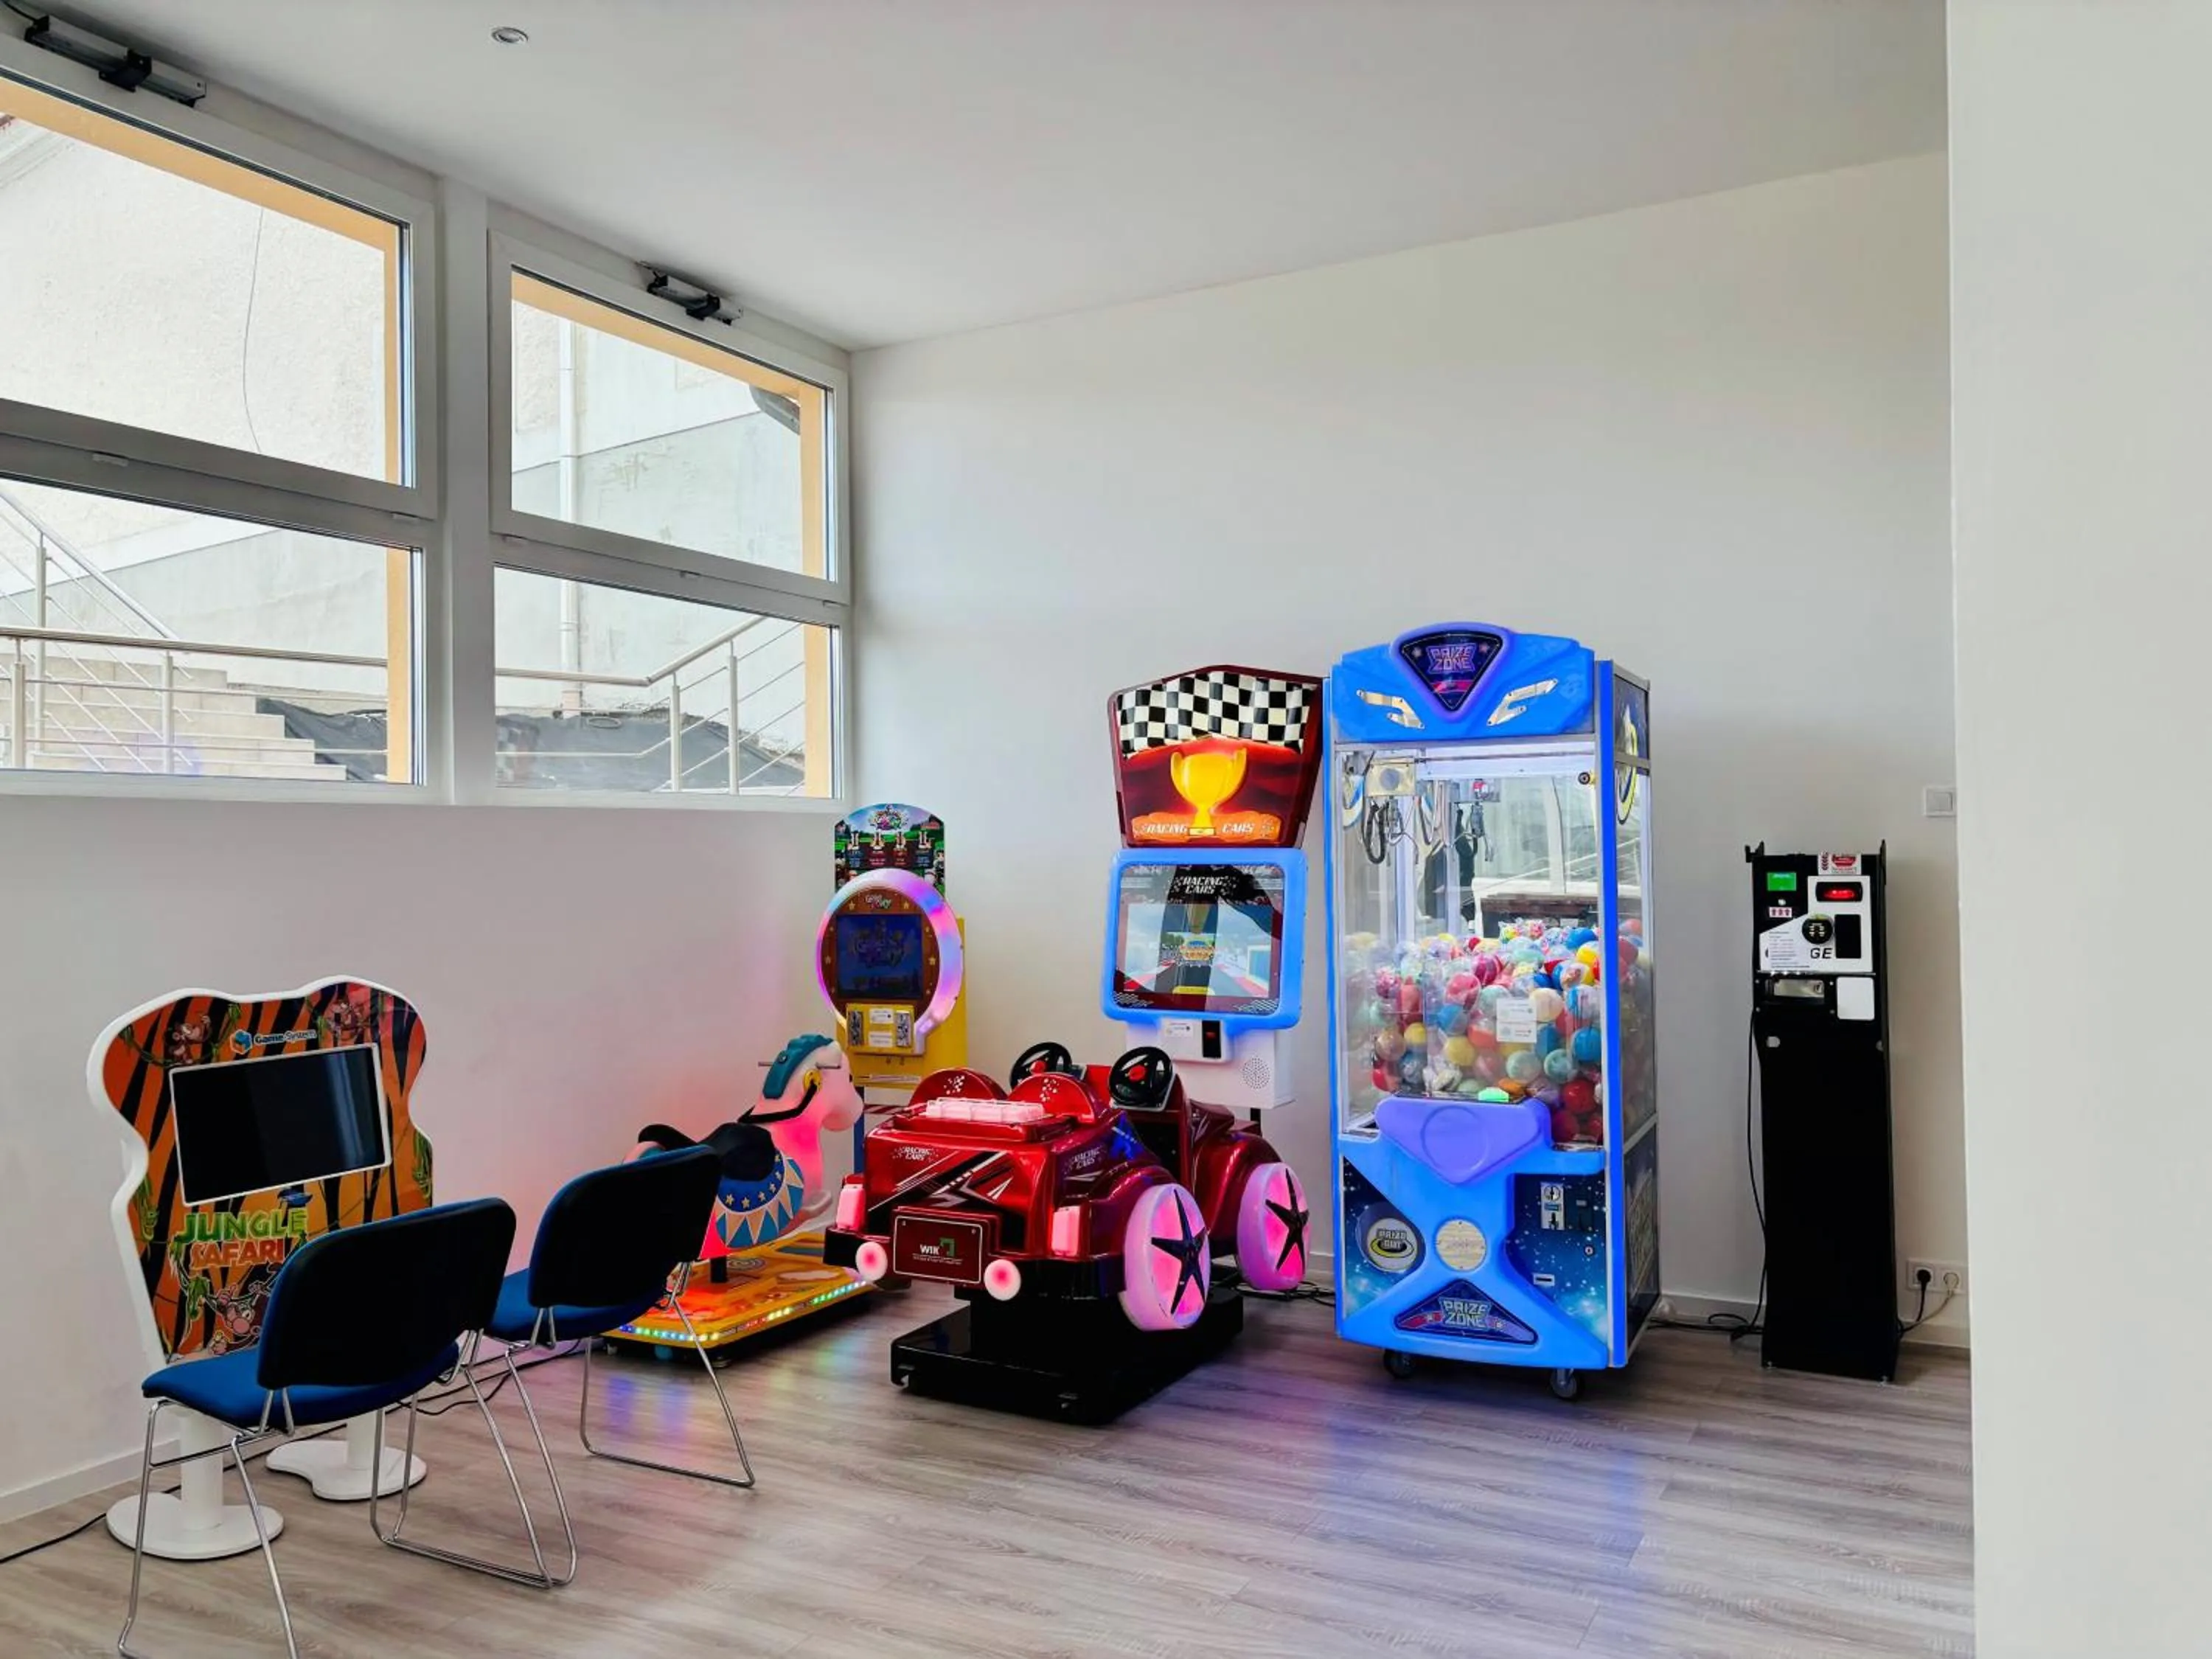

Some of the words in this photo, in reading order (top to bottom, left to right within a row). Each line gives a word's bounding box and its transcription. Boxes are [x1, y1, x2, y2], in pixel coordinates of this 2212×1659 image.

[1430, 646, 1473, 658] PRIZE
[1433, 658, 1472, 670] ZONE
[1145, 823, 1188, 834] RACING
[1222, 823, 1254, 833] CARS
[1181, 876, 1225, 886] RACING
[1185, 885, 1215, 894] CARS
[254, 1034, 285, 1045] Game
[173, 1208, 307, 1245] JUNGLE
[190, 1238, 285, 1269] SAFARI
[1443, 1300, 1488, 1314] PRIZE
[1445, 1312, 1486, 1328] ZONE
